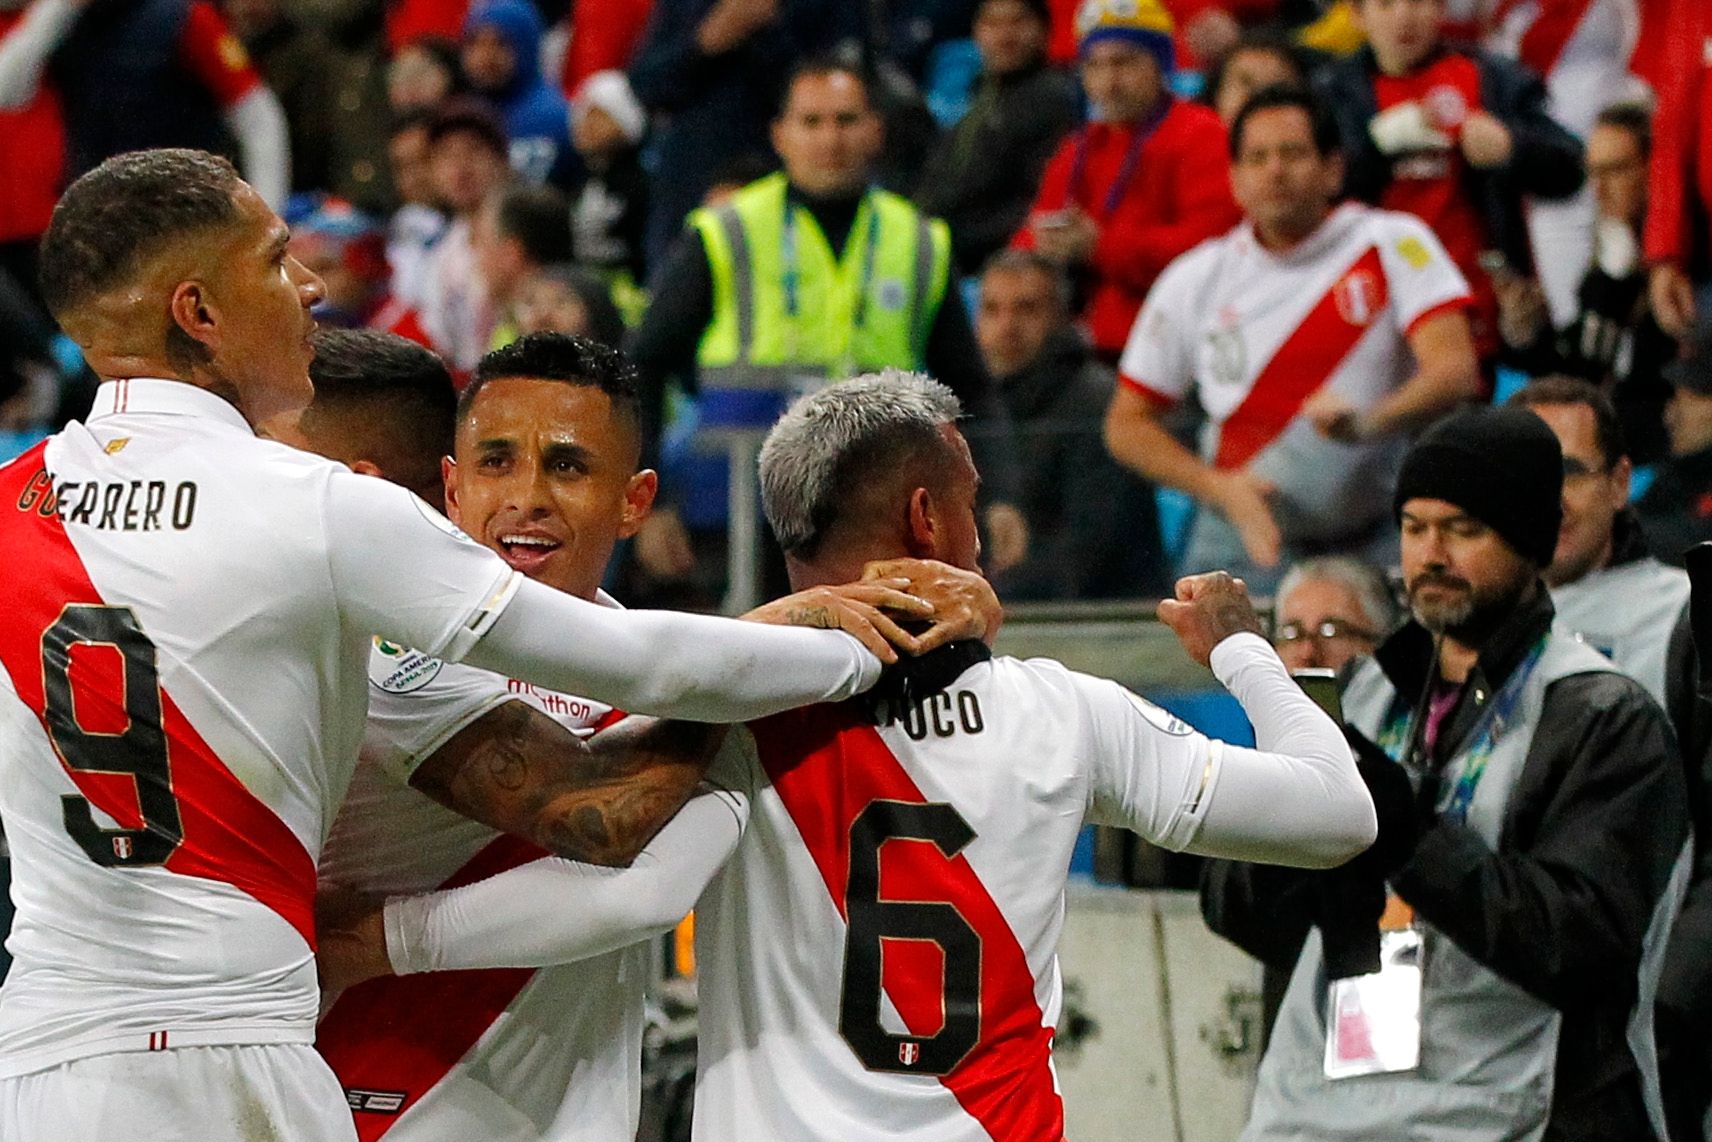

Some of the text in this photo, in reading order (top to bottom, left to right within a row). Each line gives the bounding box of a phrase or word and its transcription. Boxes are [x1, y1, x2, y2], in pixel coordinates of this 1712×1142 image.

[16, 466, 198, 532] GUERRERO
[40, 602, 185, 870] 9
[839, 798, 980, 1077] 6
